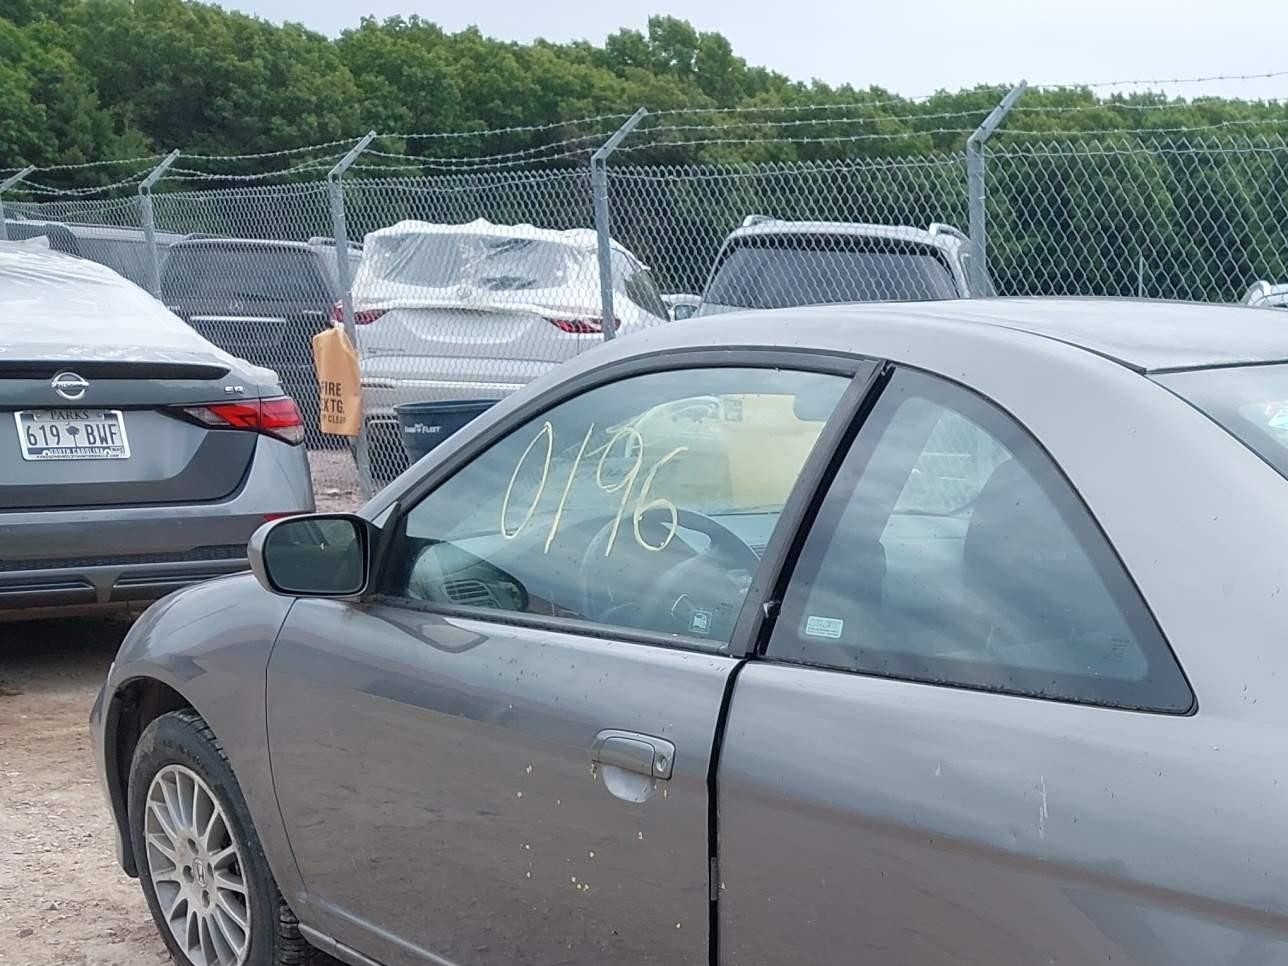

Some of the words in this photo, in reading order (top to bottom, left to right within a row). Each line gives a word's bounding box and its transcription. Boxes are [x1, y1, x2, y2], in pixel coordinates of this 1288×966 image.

[224, 385, 244, 393] SR
[321, 397, 345, 414] XTG.
[50, 409, 89, 420] PARKS
[26, 424, 61, 446] 619
[84, 423, 117, 446] BWF
[502, 422, 688, 557] 0196
